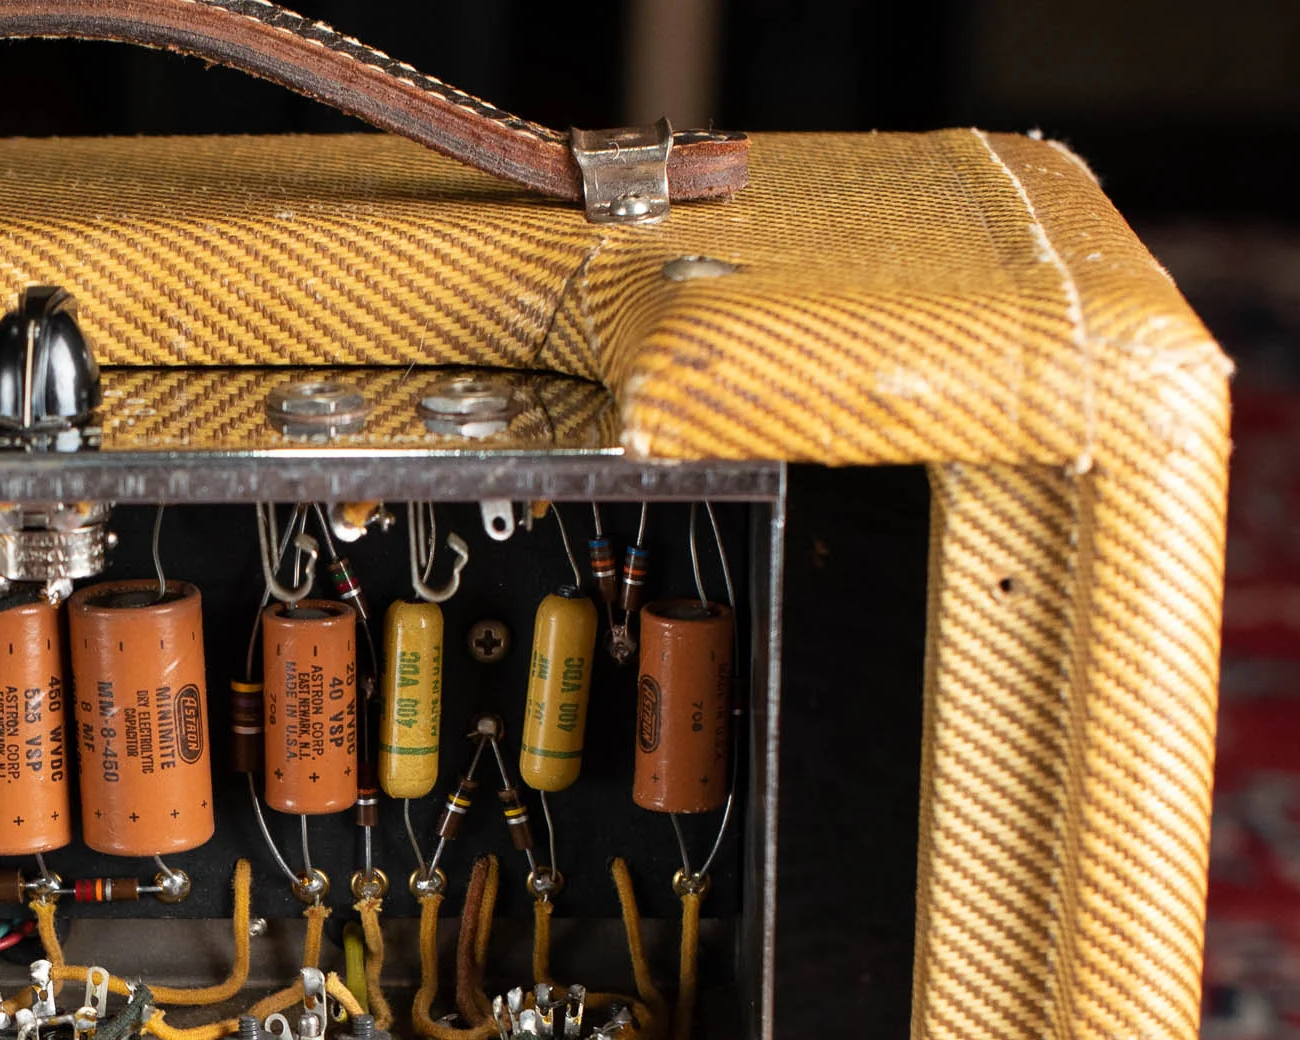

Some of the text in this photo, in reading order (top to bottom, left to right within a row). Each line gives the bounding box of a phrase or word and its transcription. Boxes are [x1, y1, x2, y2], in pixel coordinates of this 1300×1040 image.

[286, 661, 297, 763] MADE IN U.S.A.
[298, 672, 309, 694] EAST
[298, 698, 309, 738] NEWARK,
[311, 665, 323, 760] ASTRON CORP.
[329, 676, 344, 748] 40 VSP
[395, 651, 420, 729] 400 VDC
[556, 657, 585, 732] 400 VDC
[692, 700, 703, 733] 708
[6, 686, 20, 784] ASTRON CORP.
[25, 688, 43, 772] 525 VSP
[48, 676, 63, 782] 450 WVDC
[83, 723, 95, 753] MF
[97, 681, 119, 783] MM-8-450
[124, 708, 138, 757] CAPACITOR
[137, 690, 154, 774] DRY ELECTROLYTIC
[155, 687, 176, 770] MINIMITE
[183, 697, 199, 752] ASTRON
[346, 699, 355, 755] WVDC
